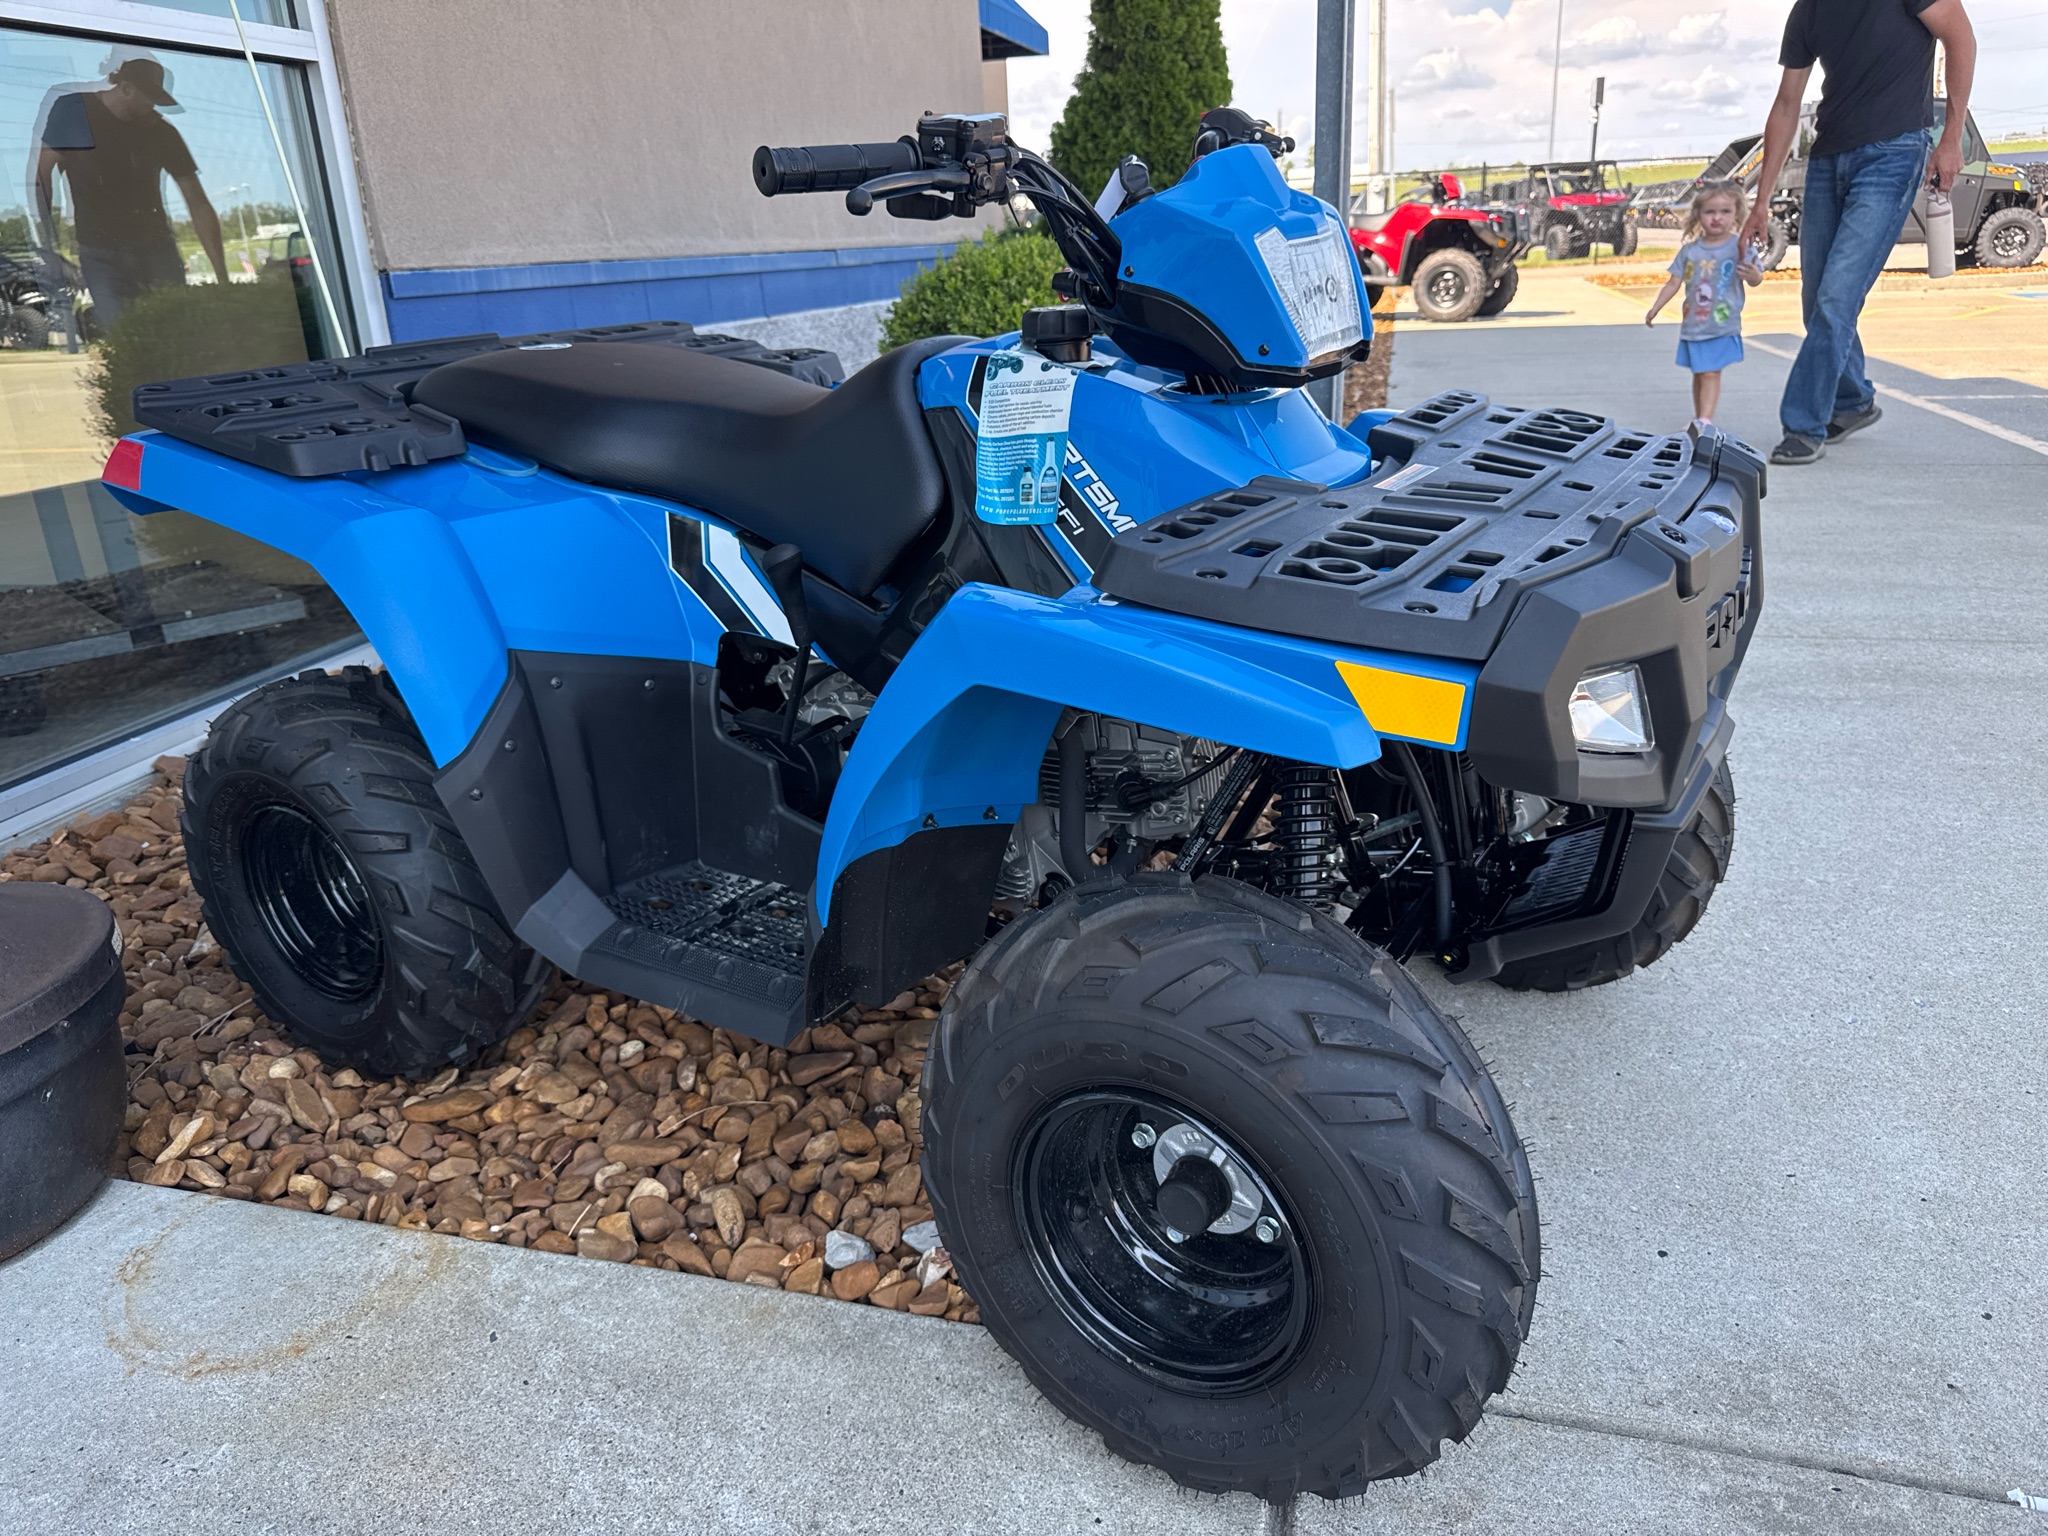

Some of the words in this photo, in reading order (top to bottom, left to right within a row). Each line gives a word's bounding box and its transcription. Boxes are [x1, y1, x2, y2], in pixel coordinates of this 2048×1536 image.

[990, 381, 1032, 389] CARBON
[1033, 378, 1067, 386] CLEAN
[985, 389, 1009, 397] FUEL
[1010, 385, 1070, 395] TREATMENT
[1179, 835, 1205, 871] POLARIS
